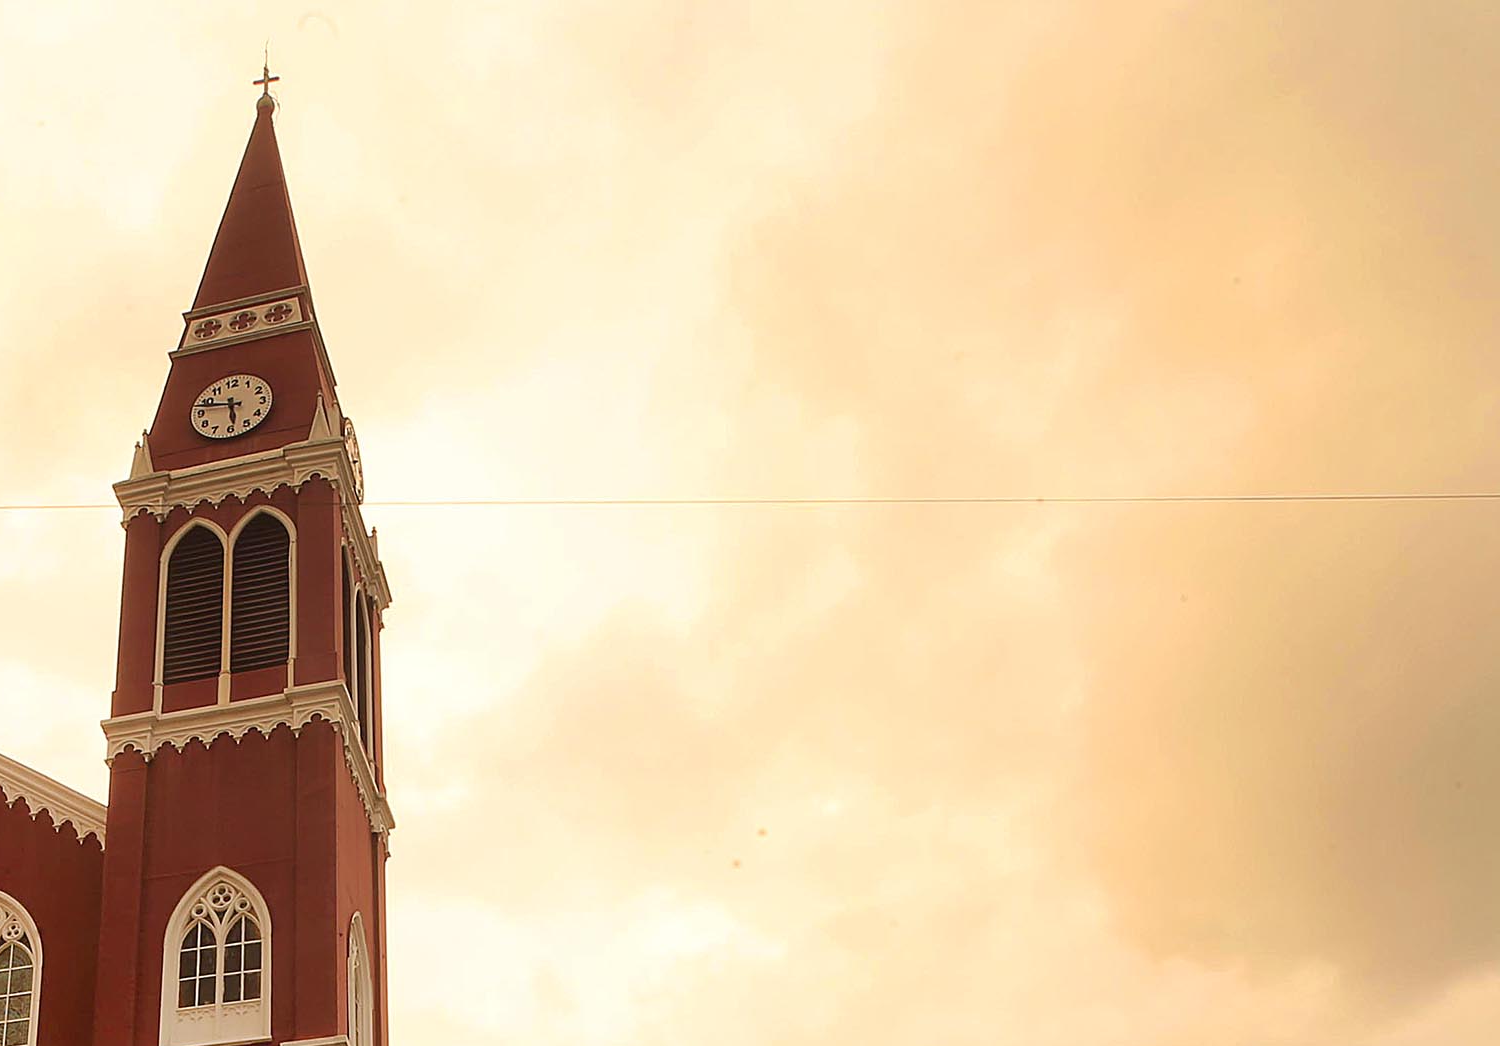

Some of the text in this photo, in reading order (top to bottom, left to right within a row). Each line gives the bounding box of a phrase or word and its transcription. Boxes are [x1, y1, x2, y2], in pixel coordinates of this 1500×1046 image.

[225, 380, 239, 389] 12
[245, 380, 250, 388] 1
[212, 387, 222, 395] 11
[254, 386, 263, 395] 2
[259, 396, 266, 404] 3
[197, 409, 205, 418] 9
[201, 420, 209, 428] 8
[243, 419, 251, 427] 5
[211, 426, 219, 434] 7
[227, 425, 235, 433] 6
